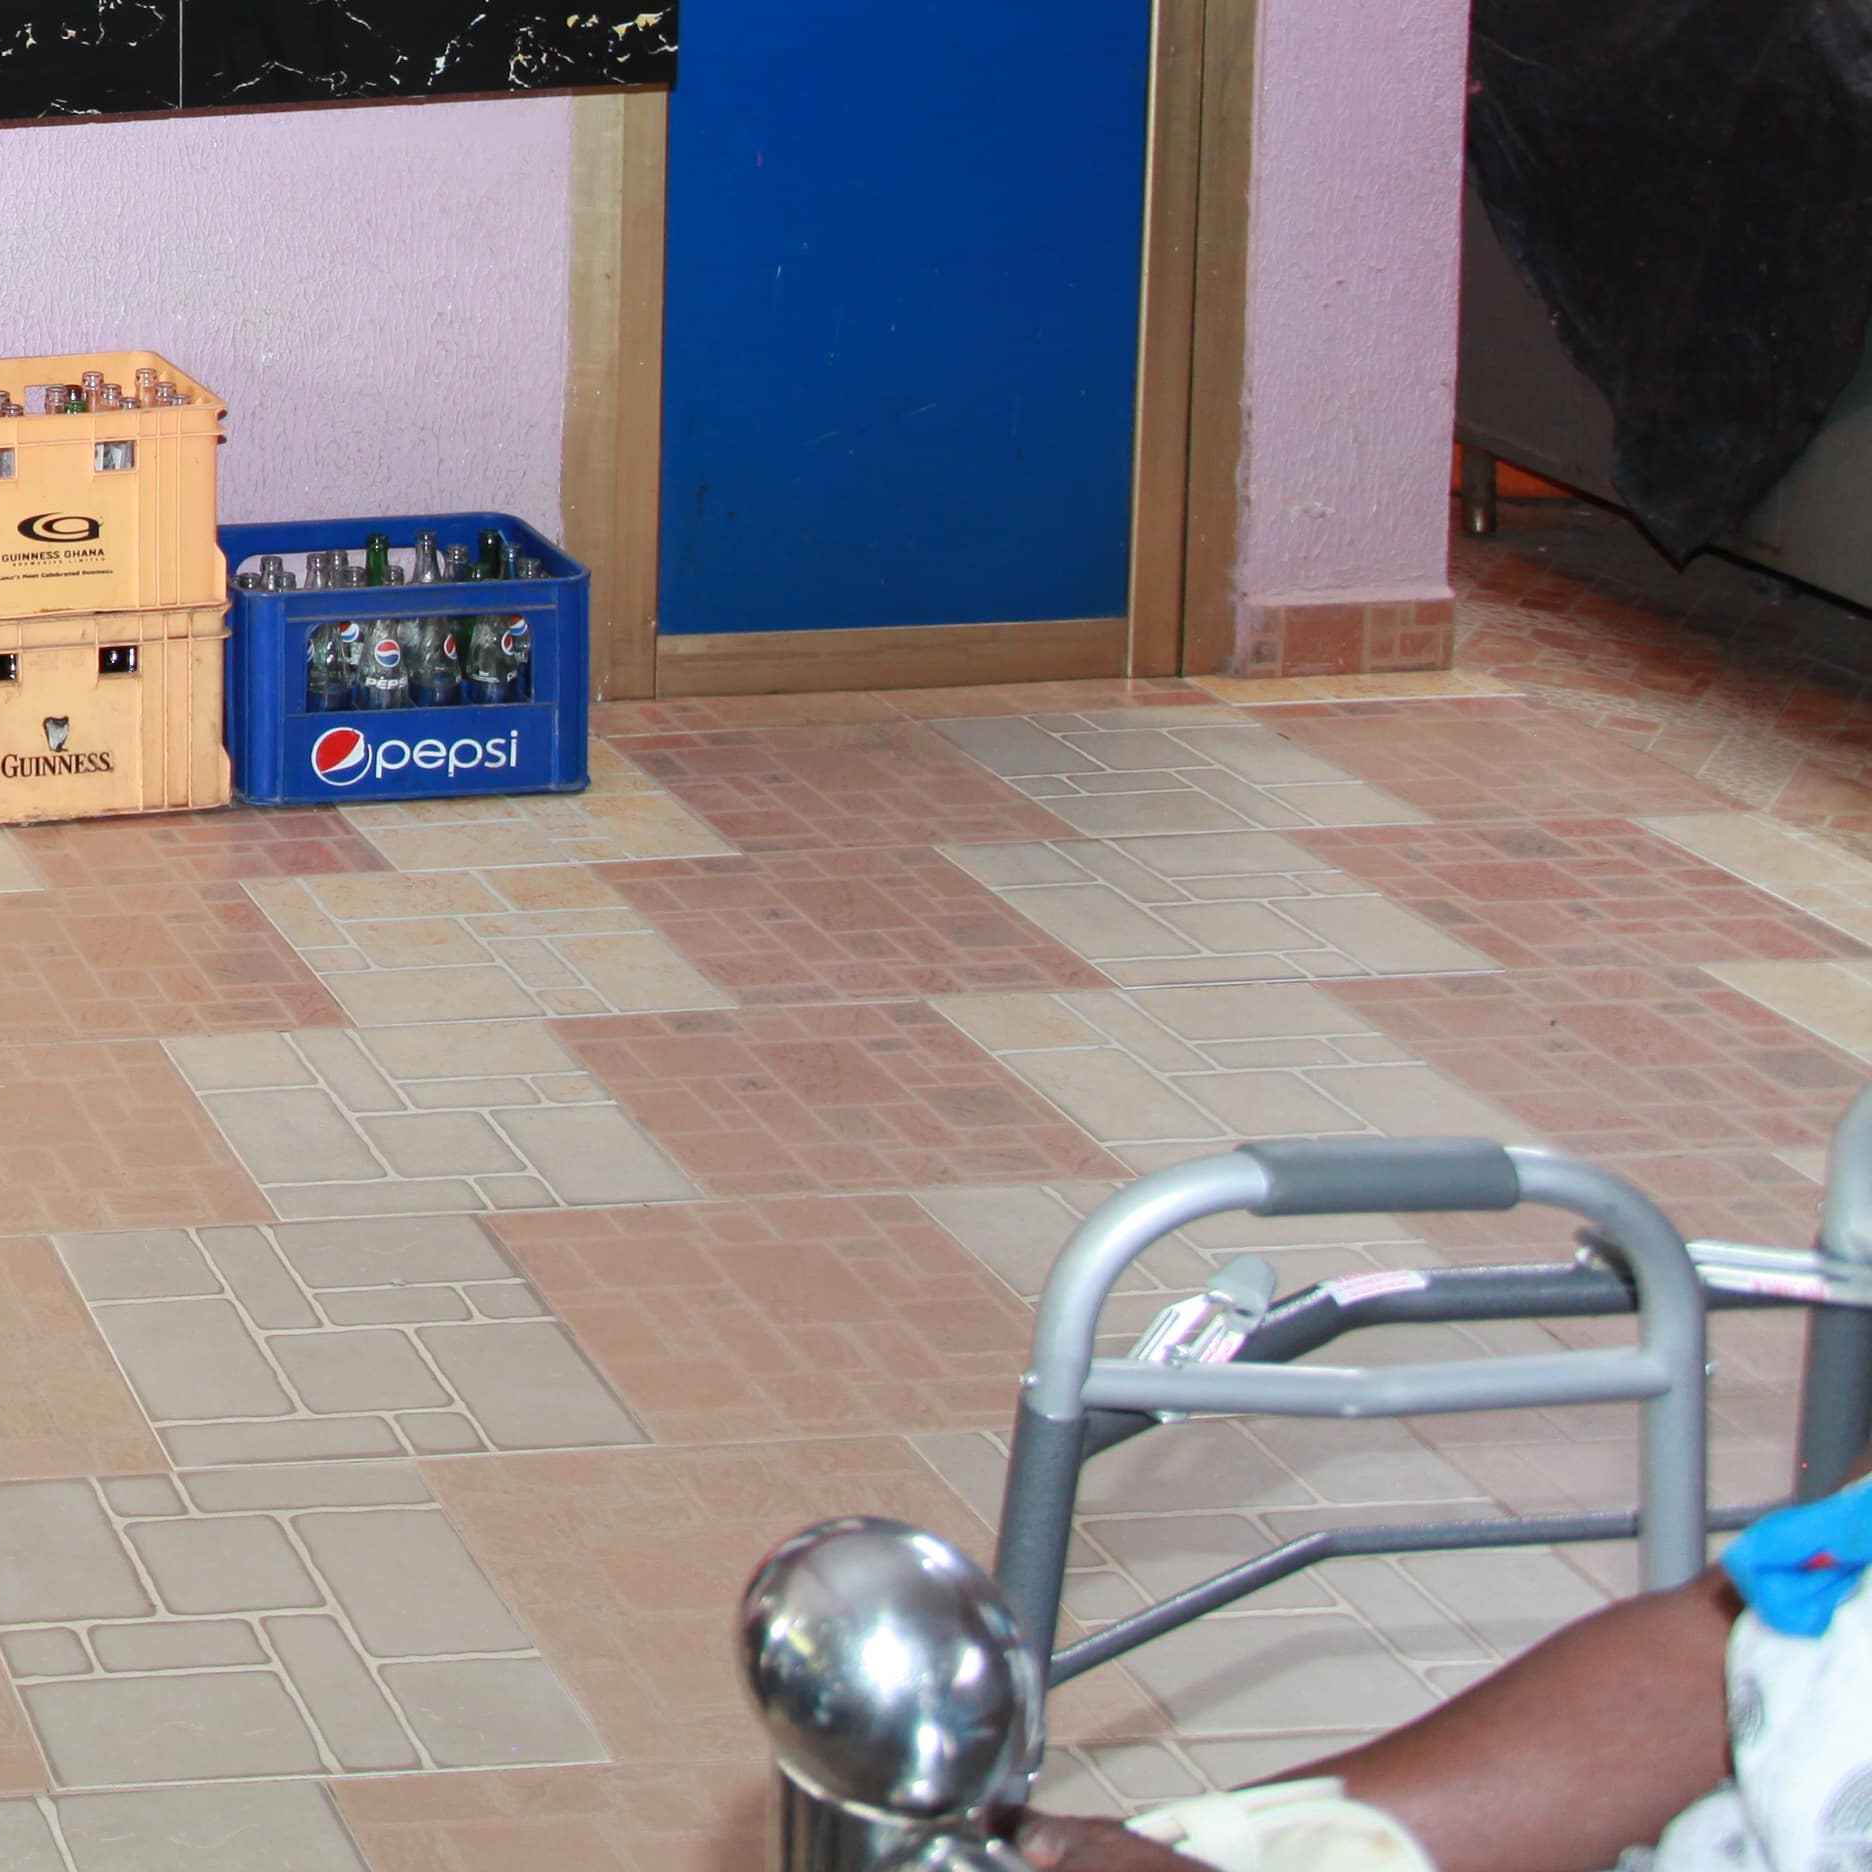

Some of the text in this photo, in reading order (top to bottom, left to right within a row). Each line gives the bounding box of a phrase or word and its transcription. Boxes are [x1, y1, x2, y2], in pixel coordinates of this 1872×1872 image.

[1, 548, 105, 563] GUINNESS GHANA
[0, 751, 112, 779] GUINNESS
[375, 729, 519, 779] pepsi
